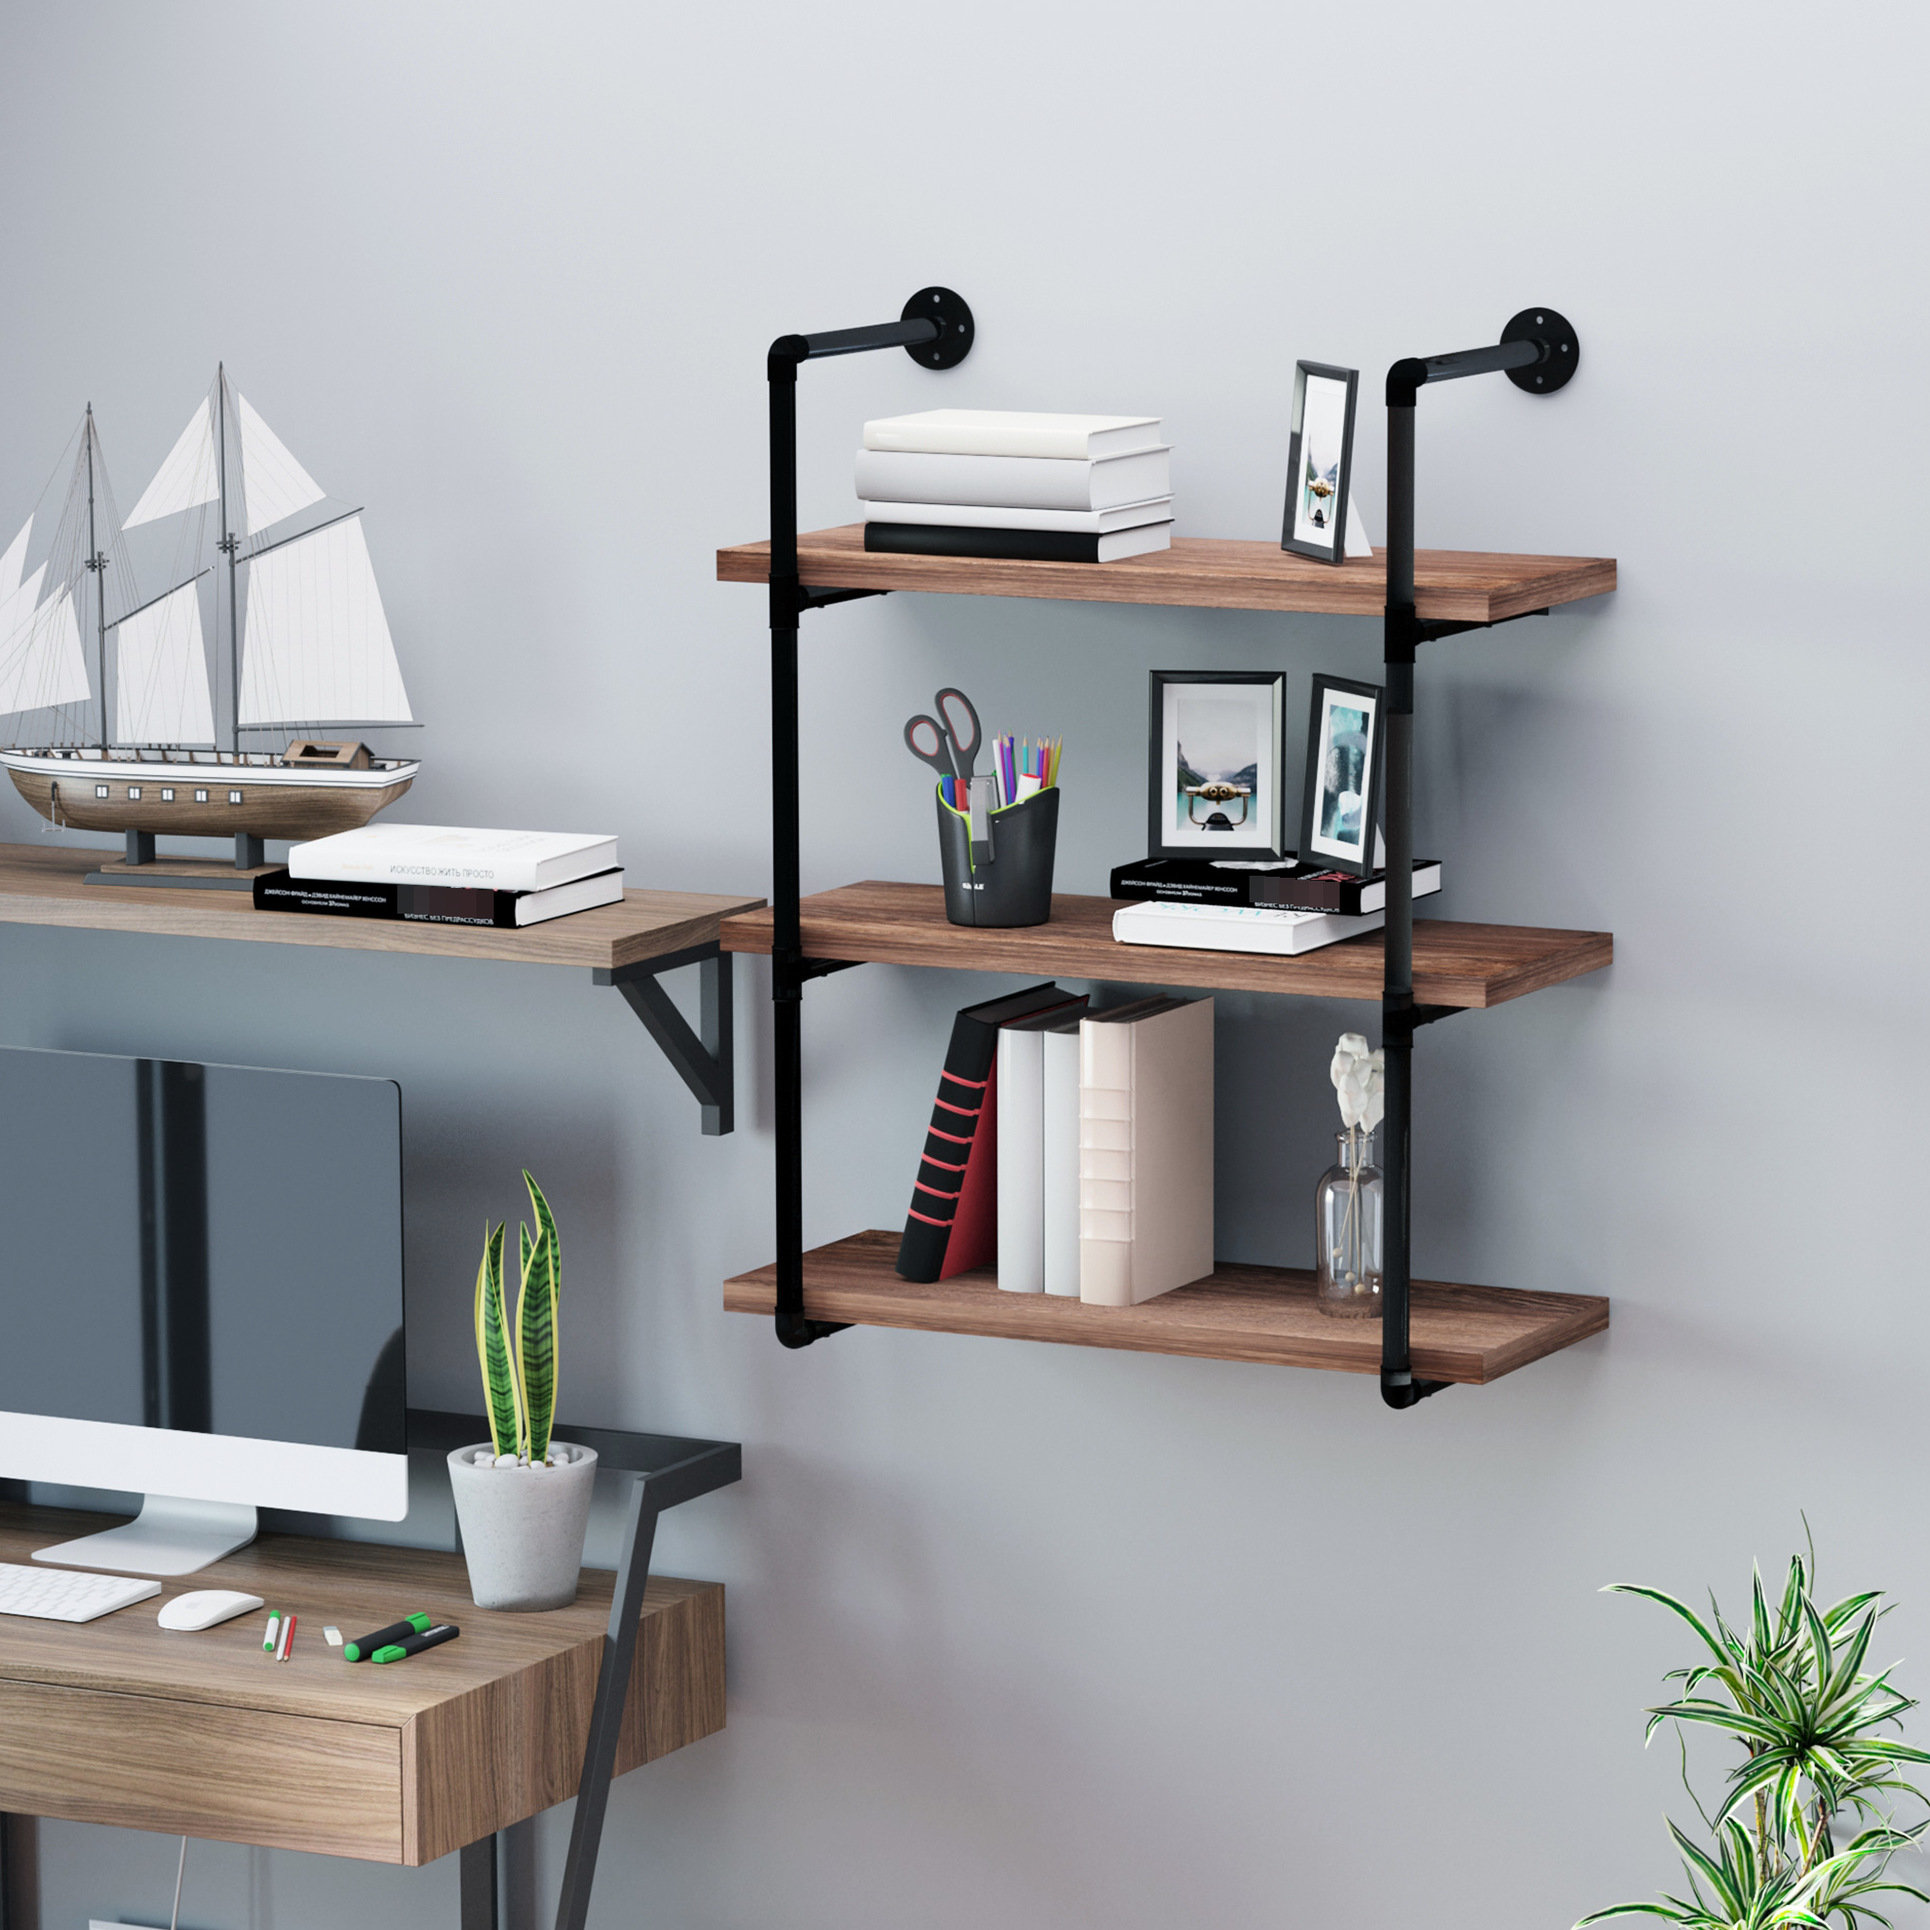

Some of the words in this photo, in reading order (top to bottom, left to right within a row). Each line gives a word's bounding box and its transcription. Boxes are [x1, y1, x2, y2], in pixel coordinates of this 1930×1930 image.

[390, 865, 437, 876] ИСКУССТВО
[438, 867, 460, 877] ЖИТЬ
[462, 868, 495, 879] ПРОСТО
